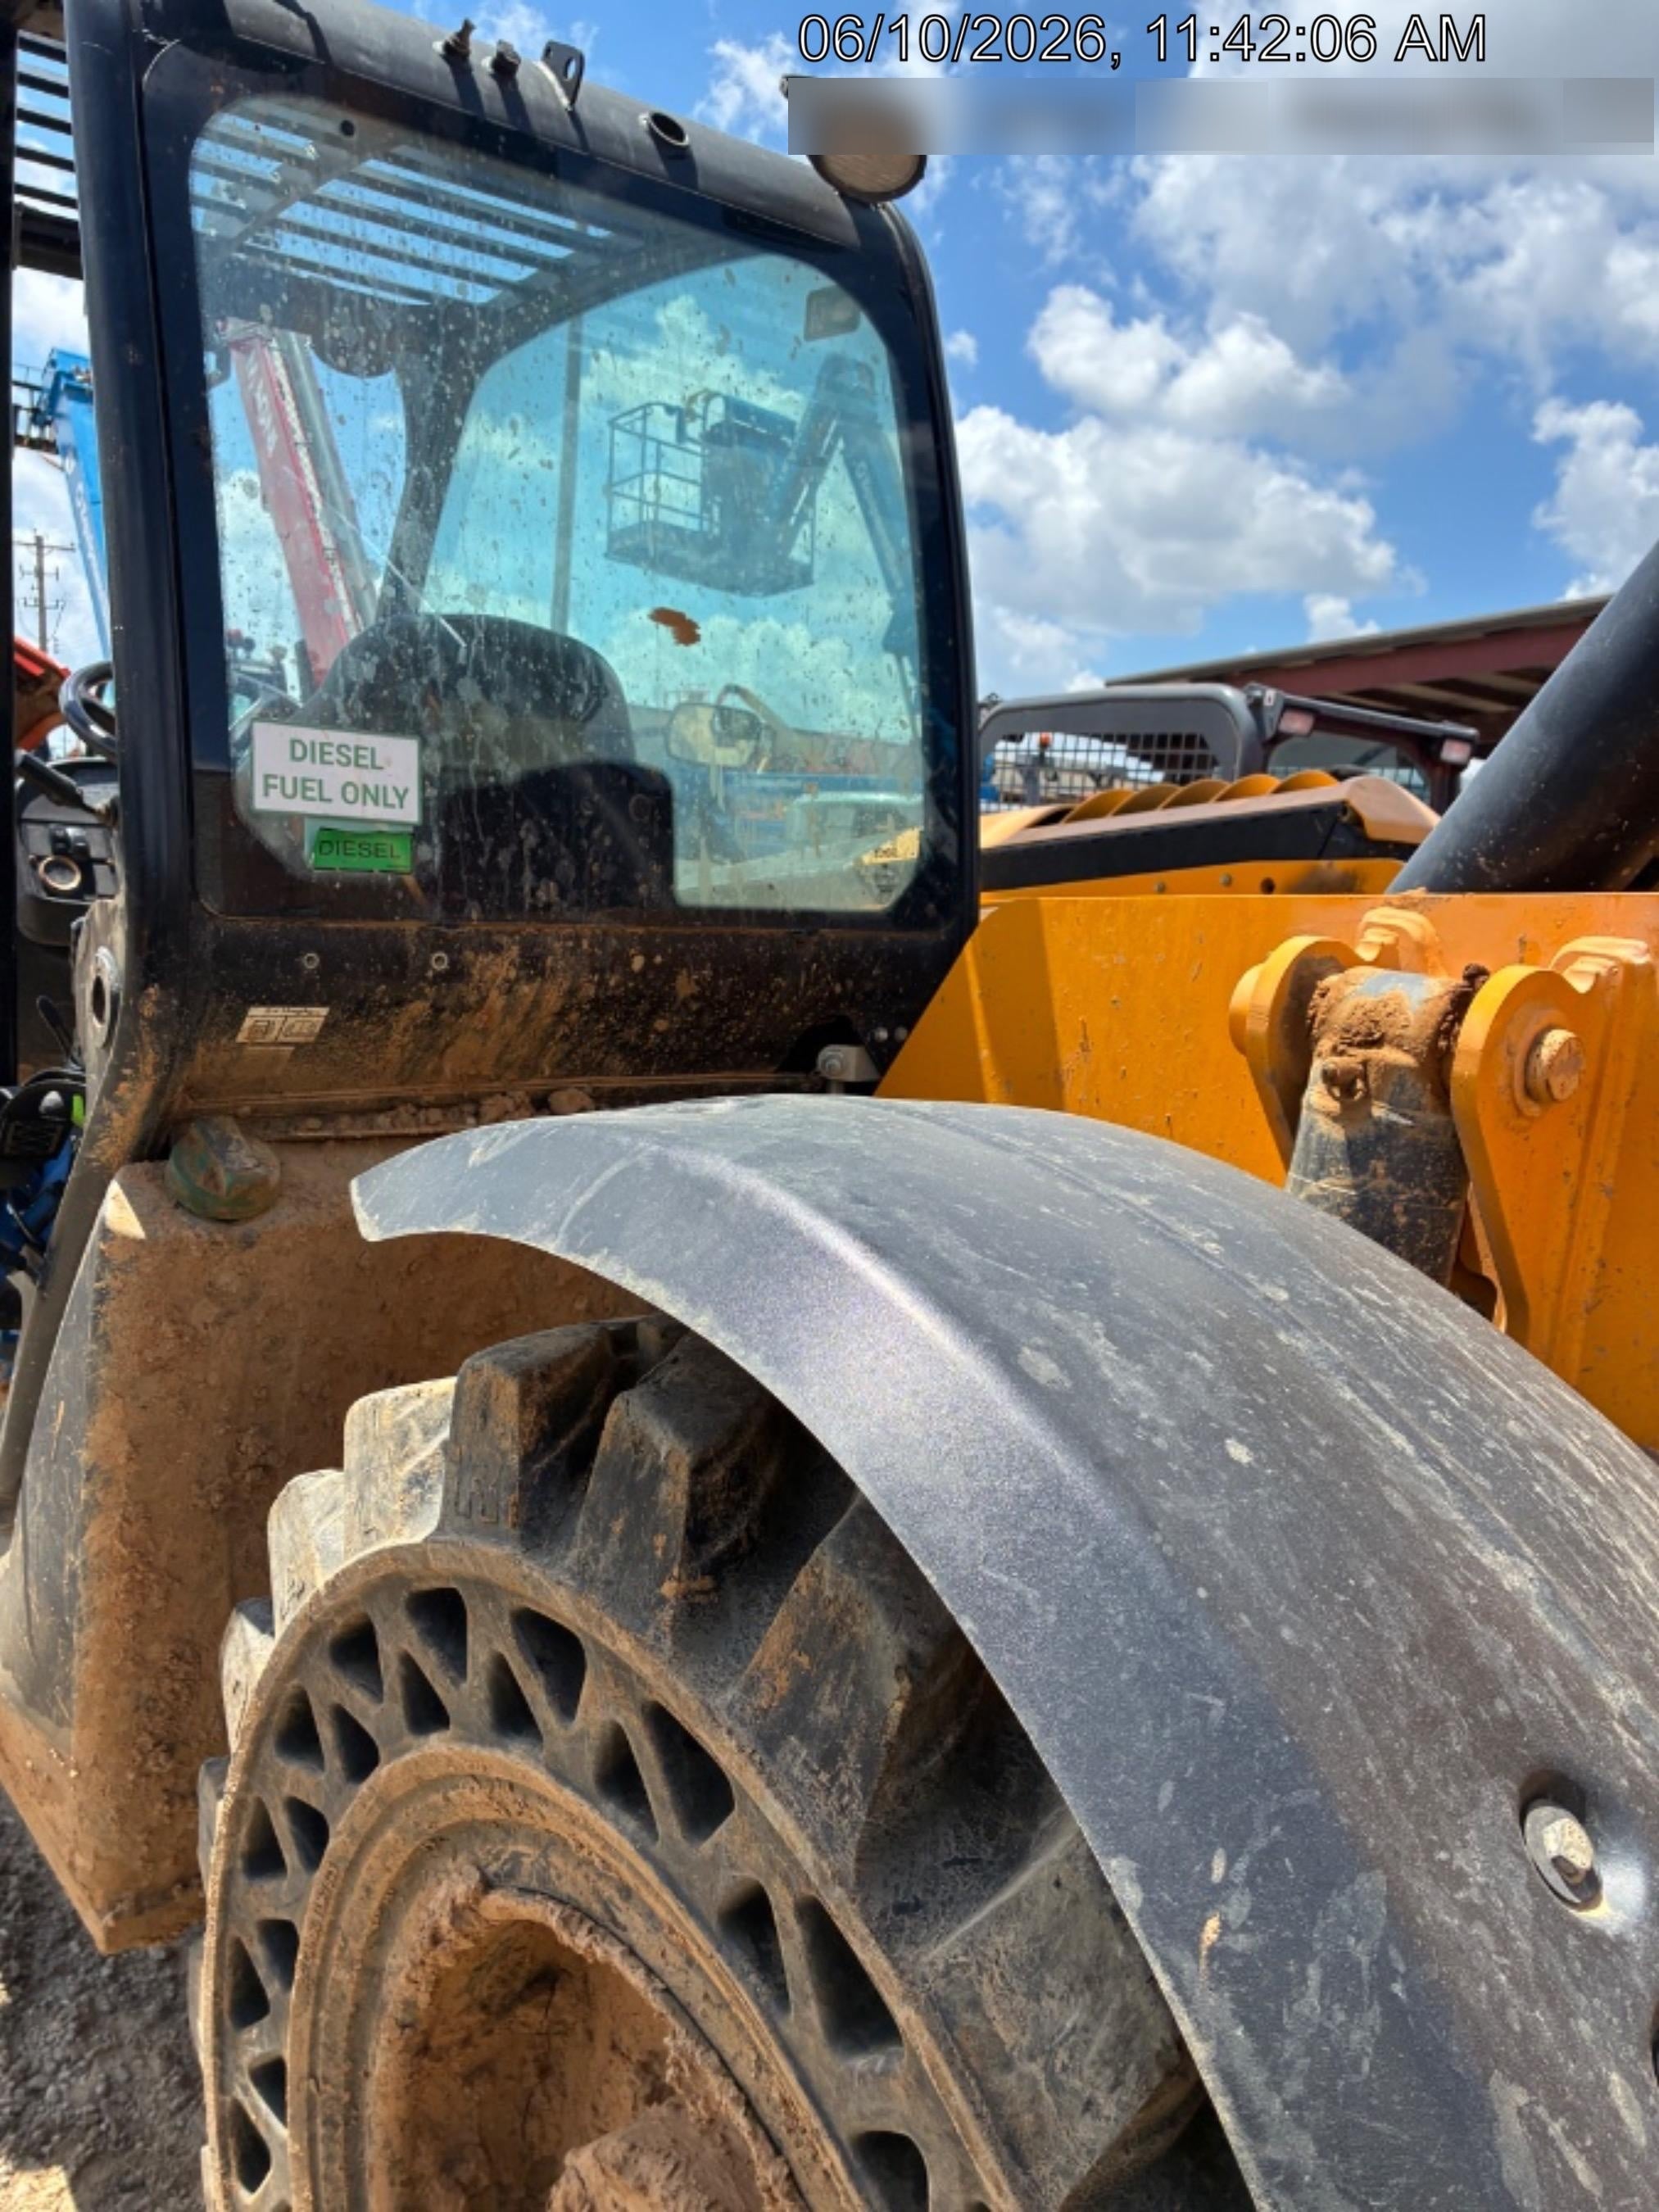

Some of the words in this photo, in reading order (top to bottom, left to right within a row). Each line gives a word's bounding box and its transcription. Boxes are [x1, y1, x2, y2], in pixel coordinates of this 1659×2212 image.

[290, 738, 384, 770] DIESEL
[262, 773, 333, 803] FUEL
[341, 781, 409, 809] ONLY
[319, 839, 401, 859] DIESEL
